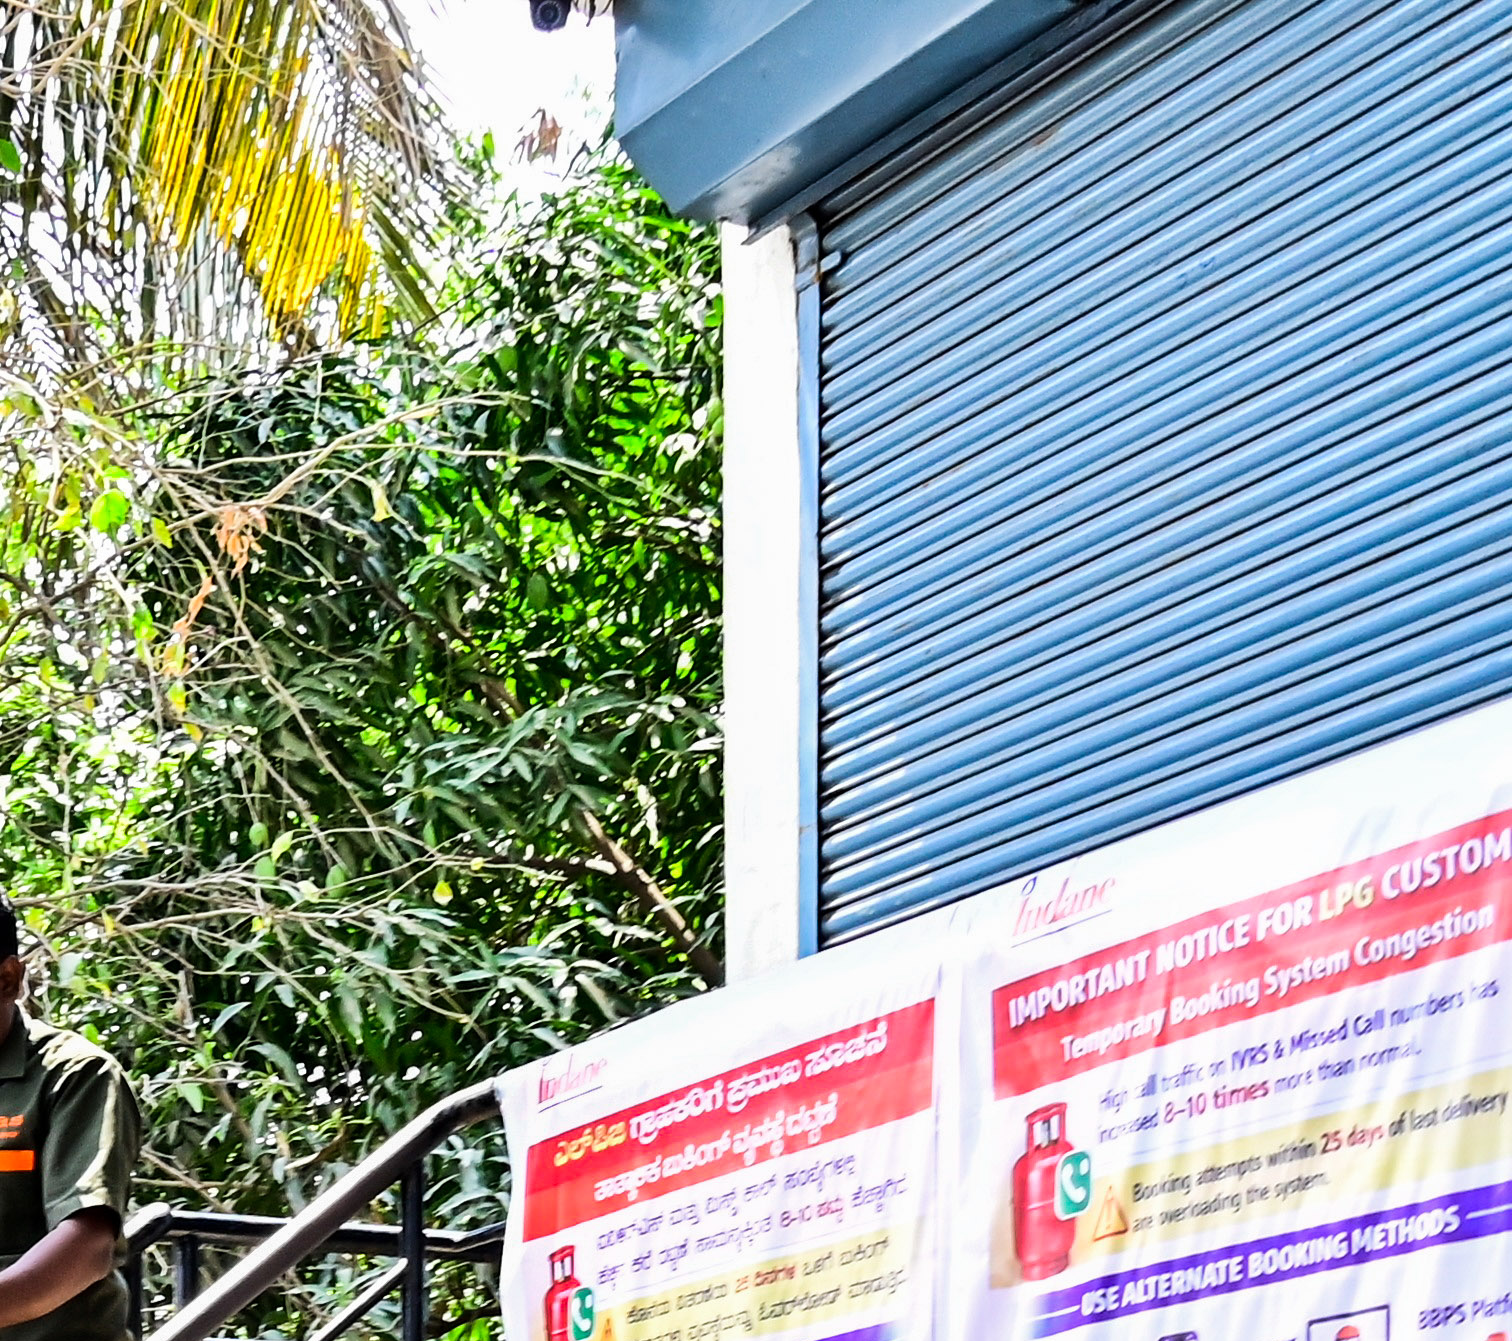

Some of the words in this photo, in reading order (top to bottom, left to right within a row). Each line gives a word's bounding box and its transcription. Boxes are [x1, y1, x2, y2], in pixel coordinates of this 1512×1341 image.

[1008, 949, 1150, 1030] IMPORTANT
[1156, 913, 1251, 976] NOTICE
[1256, 895, 1314, 942] FOR
[1318, 874, 1375, 922] LPG
[1061, 1007, 1167, 1062] Temporary
[1170, 976, 1260, 1025] Booking
[1265, 947, 1350, 999] System
[1354, 904, 1497, 966] Congestion
[1291, 1018, 1348, 1052] Missed
[1353, 1008, 1384, 1037] Call
[1133, 1172, 1192, 1204] Booking
[1197, 1155, 1263, 1185] attempts
[1320, 1129, 1342, 1154] 25
[1347, 1123, 1384, 1149] days
[1389, 1111, 1407, 1138] of
[1443, 1090, 1509, 1122] delivery
[1213, 1080, 1270, 1110] times
[1081, 1286, 1119, 1317] USE
[1121, 1255, 1244, 1309] ALTERNATE
[1248, 1231, 1349, 1279] BOOKING
[1351, 1204, 1460, 1255] METHODS
